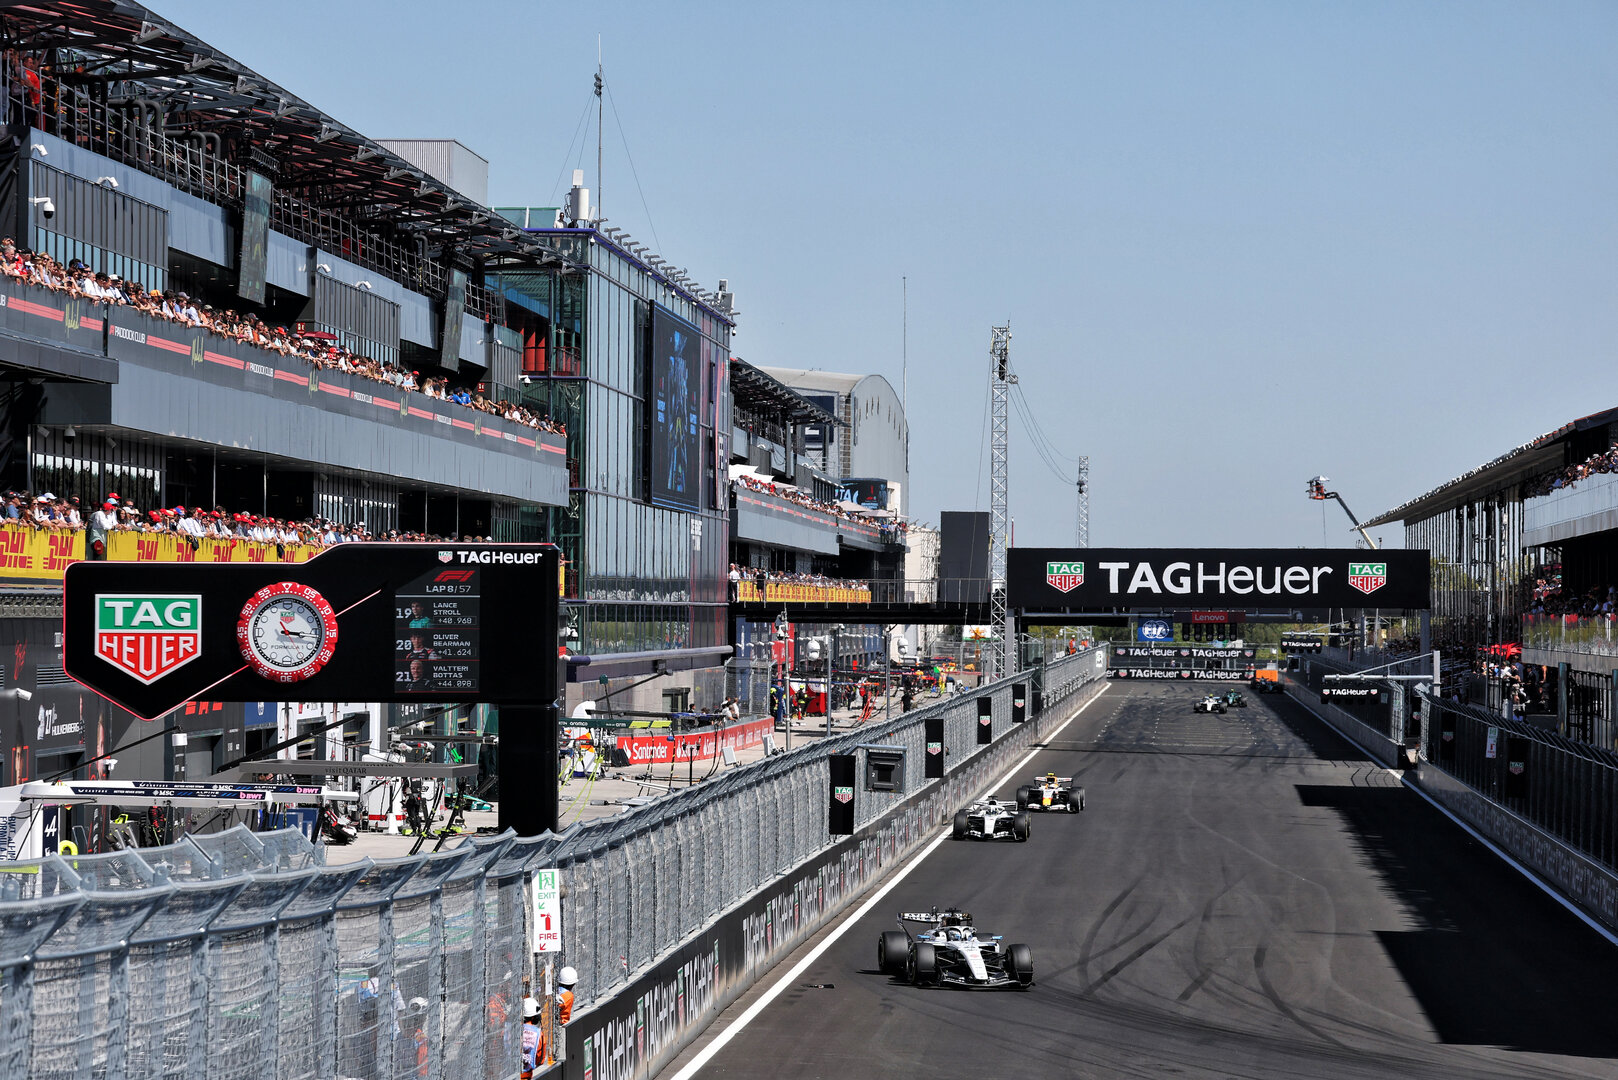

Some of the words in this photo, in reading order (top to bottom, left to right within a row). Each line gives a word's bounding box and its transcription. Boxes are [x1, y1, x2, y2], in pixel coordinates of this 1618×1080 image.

[457, 550, 543, 564] TAGHeuer
[1050, 564, 1081, 574] TAG
[1351, 565, 1383, 575] TAG
[1049, 575, 1082, 591] HEUER
[1099, 562, 1334, 595] TAGHeuer
[426, 585, 446, 593] LAP
[1350, 577, 1384, 593] HEUER
[258, 588, 271, 598] 55
[303, 588, 316, 599] 05
[104, 601, 192, 627] TAG
[242, 603, 253, 616] 50
[322, 605, 332, 615] 10
[396, 607, 412, 619] 19
[237, 627, 244, 638] 45
[329, 629, 337, 638] 15
[396, 640, 412, 650] 20
[102, 635, 195, 677] HEUER
[241, 649, 251, 661] 40
[321, 652, 332, 663] 20
[1128, 648, 1178, 657] TAGHeuer
[1192, 648, 1242, 658] TAGHeuer
[258, 668, 270, 677] 35
[303, 667, 316, 678] 25
[395, 671, 411, 682] 21
[1129, 669, 1180, 678] TAGHeuer
[1192, 670, 1243, 679] TAGHeuer
[1331, 688, 1369, 696] TAGHeuer
[632, 743, 668, 760] Santander
[537, 892, 557, 900] EXIT
[539, 932, 558, 940] FIRE
